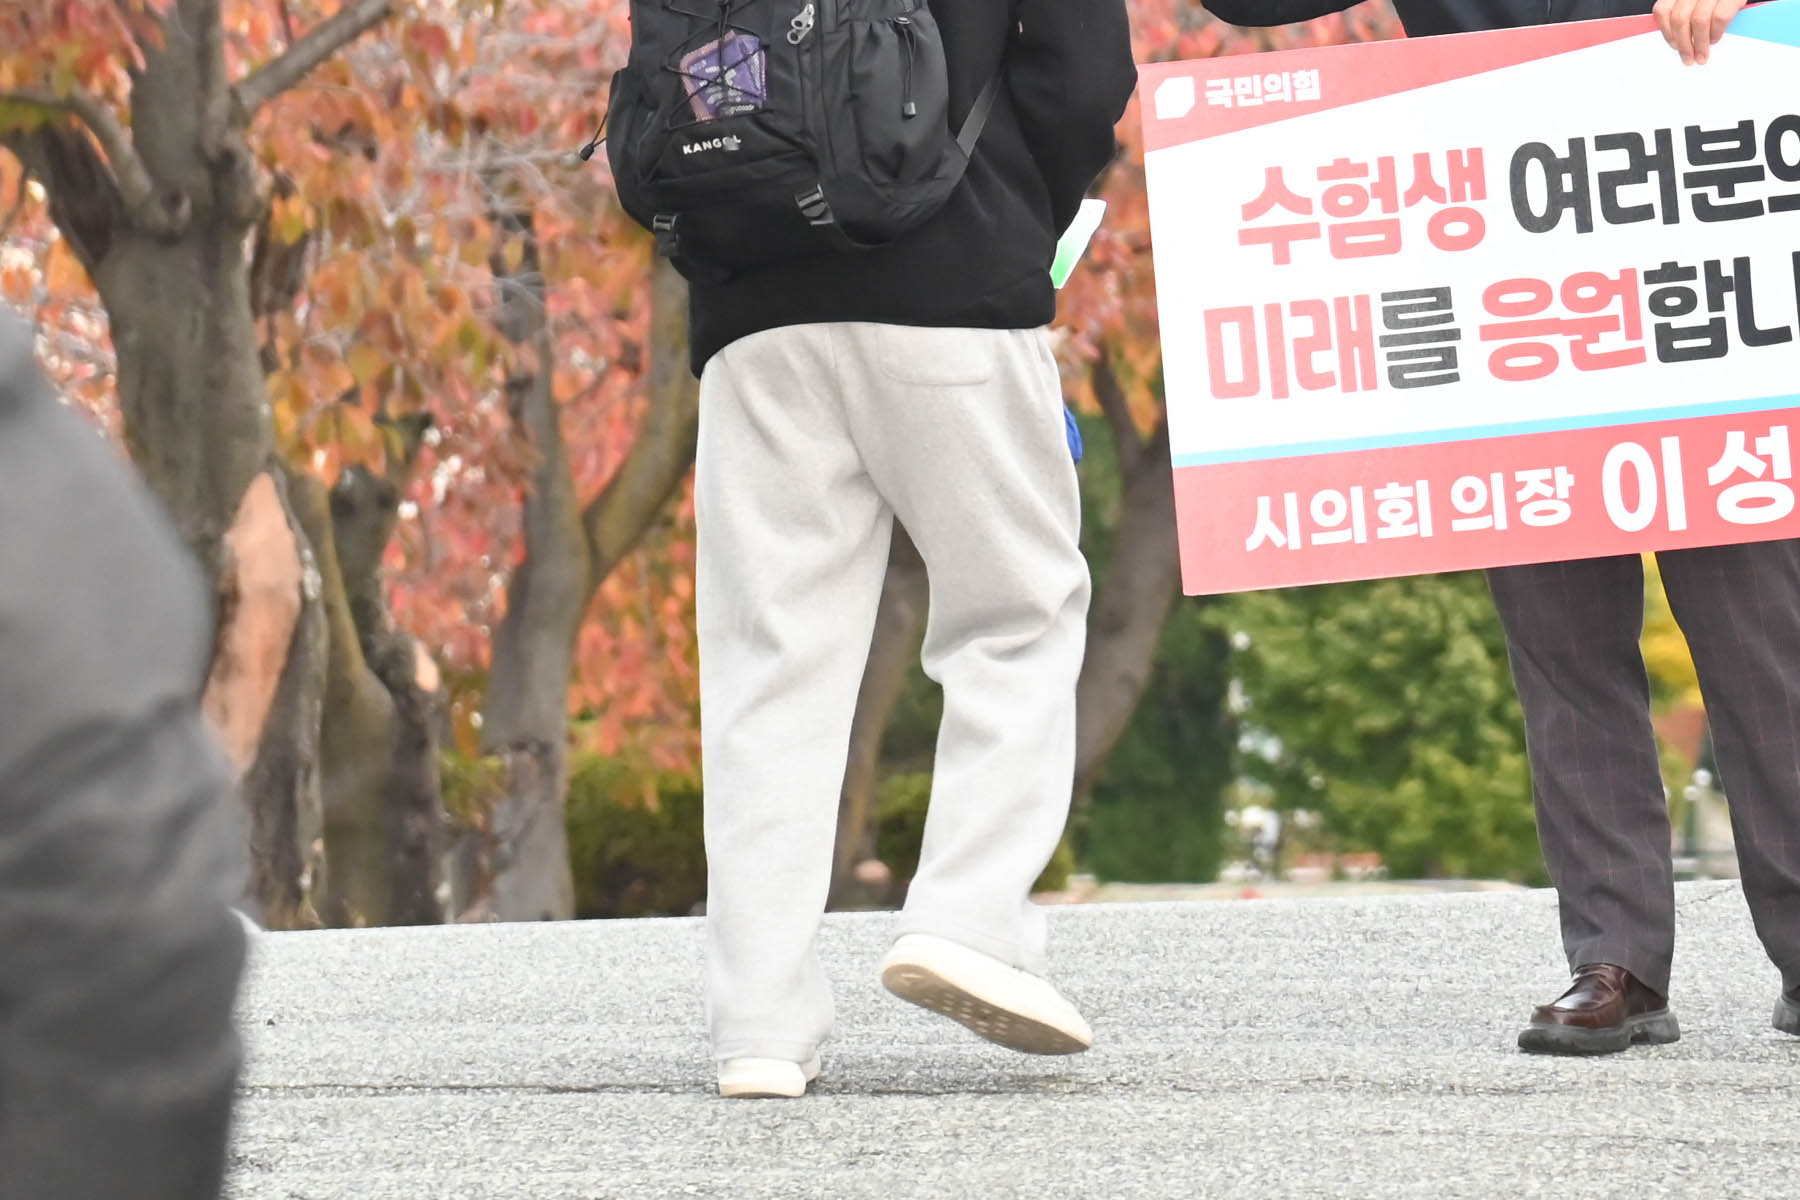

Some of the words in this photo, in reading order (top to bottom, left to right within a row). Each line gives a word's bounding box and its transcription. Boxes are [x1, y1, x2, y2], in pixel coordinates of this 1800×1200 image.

[1205, 69, 1321, 108] 국민의힘
[1237, 147, 1487, 266] 수험생
[1203, 286, 1461, 400] 미래를
[1245, 478, 1432, 551] 시의회
[1450, 468, 1574, 531] 의장
